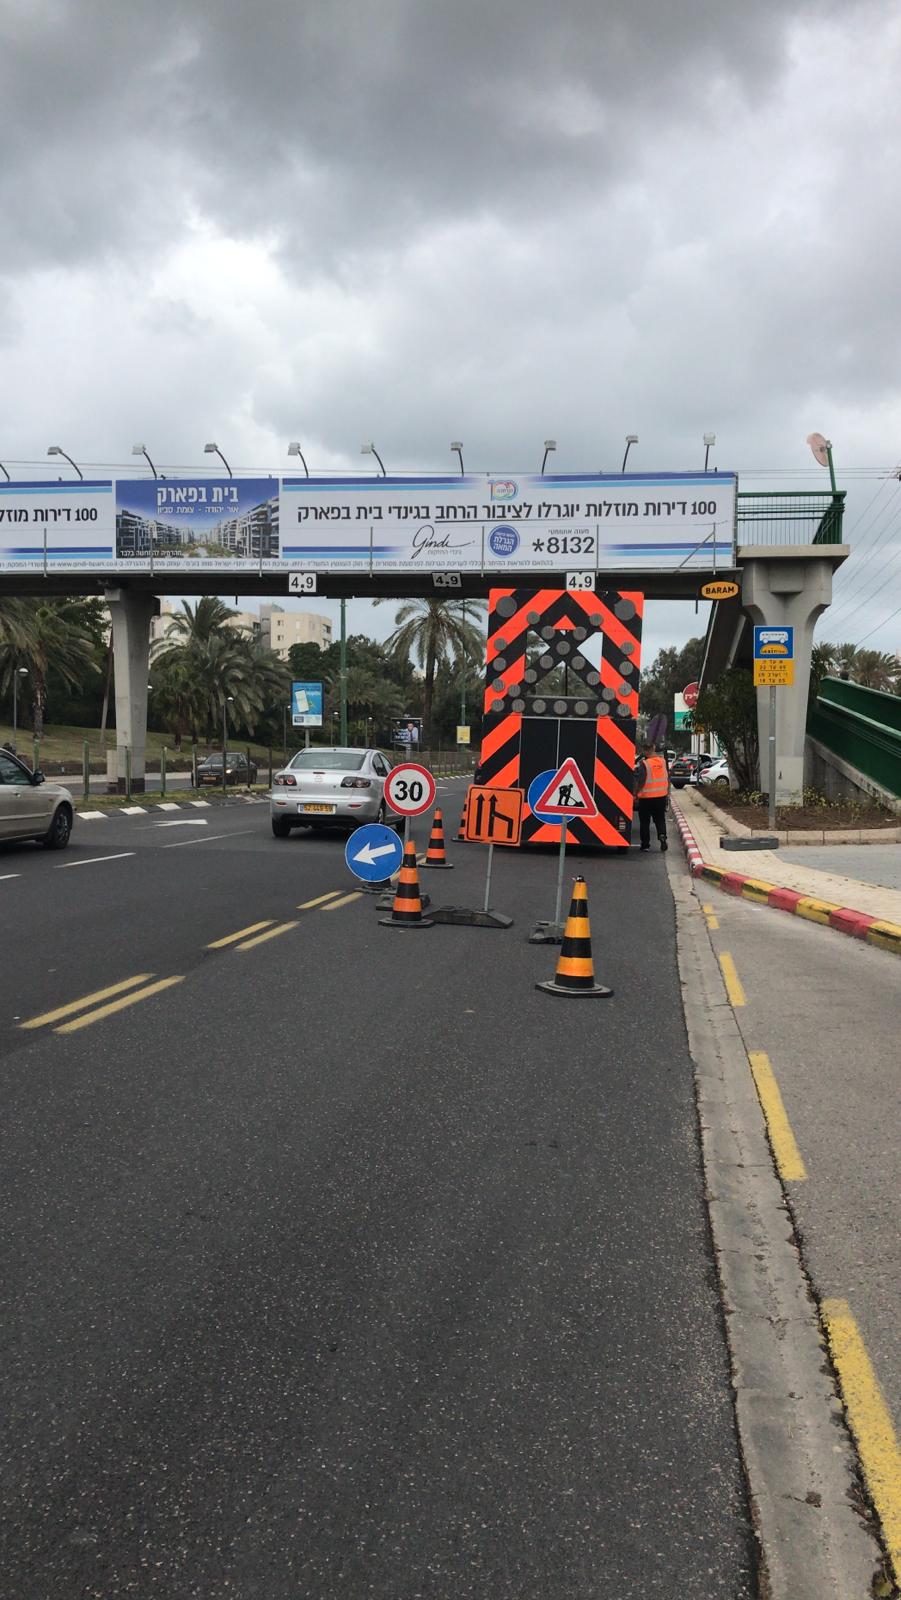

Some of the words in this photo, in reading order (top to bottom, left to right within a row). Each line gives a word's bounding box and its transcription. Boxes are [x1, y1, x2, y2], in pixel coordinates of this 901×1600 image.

[157, 487, 207, 506] בפארק
[212, 487, 238, 503] בית
[75, 508, 97, 521] 100
[298, 506, 351, 523] בפארק
[356, 506, 383, 520] בית
[389, 506, 431, 520] בגינדי
[435, 505, 477, 519] הרחב
[482, 502, 533, 519] לציבור
[538, 502, 579, 518] יוגרלו
[585, 501, 638, 517] מוזלות
[643, 502, 687, 516] דירות
[691, 501, 716, 515] 100
[33, 509, 71, 522] דירות
[291, 577, 313, 588] 4.9
[436, 576, 458, 584] 4.9
[568, 576, 592, 588] 4.9
[706, 586, 734, 594] BARAM
[395, 780, 423, 802] 30
